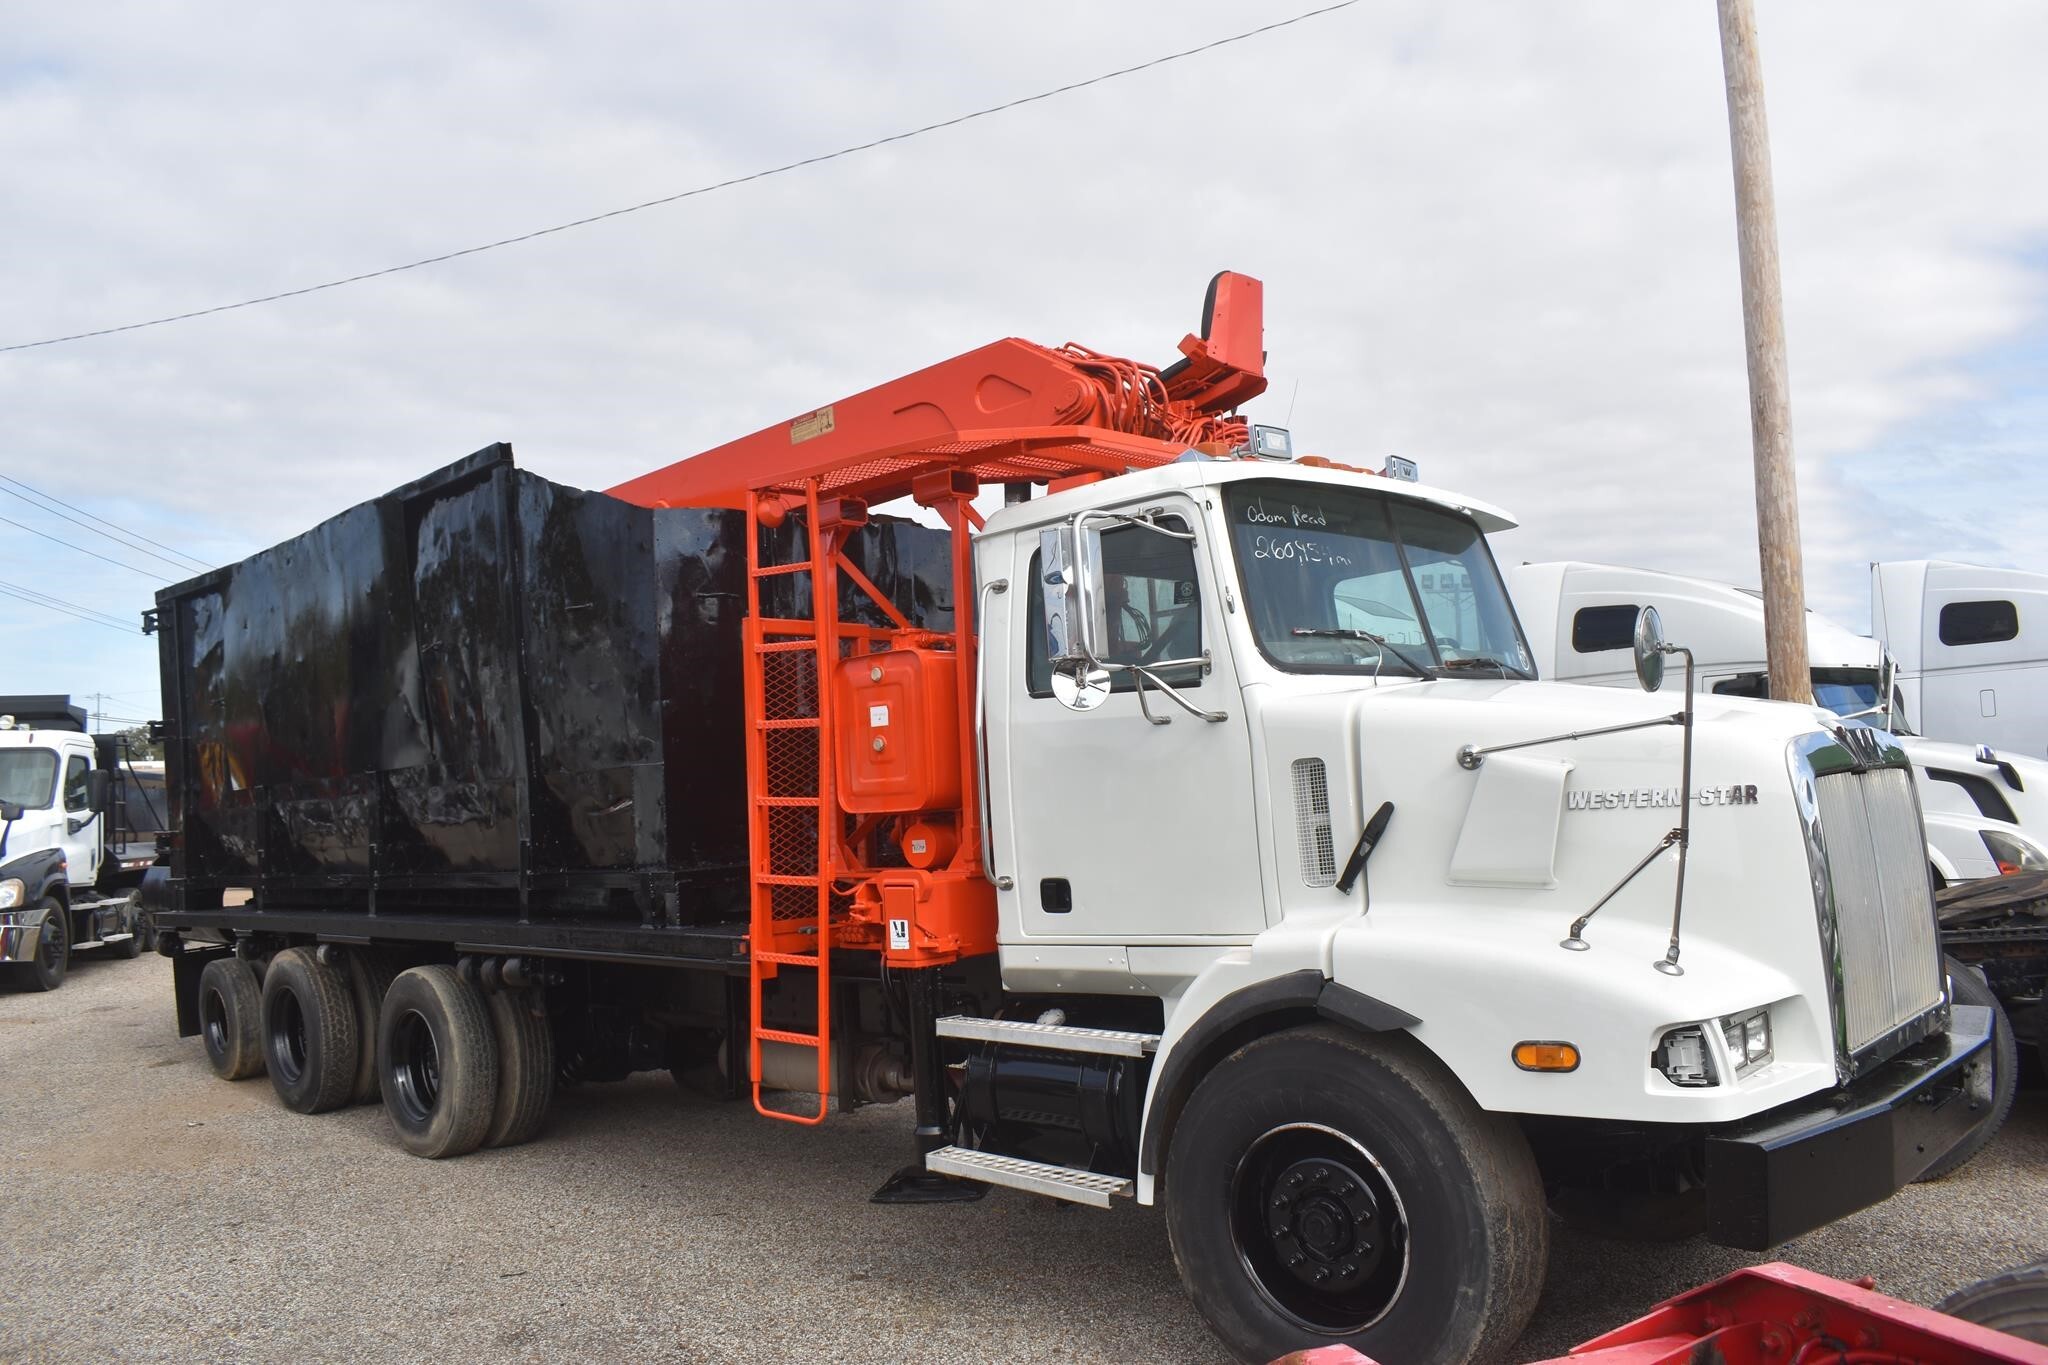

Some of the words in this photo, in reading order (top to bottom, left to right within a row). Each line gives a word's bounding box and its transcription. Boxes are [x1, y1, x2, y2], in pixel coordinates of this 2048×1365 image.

[1247, 497, 1287, 523] Odom
[1291, 504, 1329, 527] Read
[1568, 787, 1681, 810] WESTERN
[1699, 784, 1759, 807] STAR
